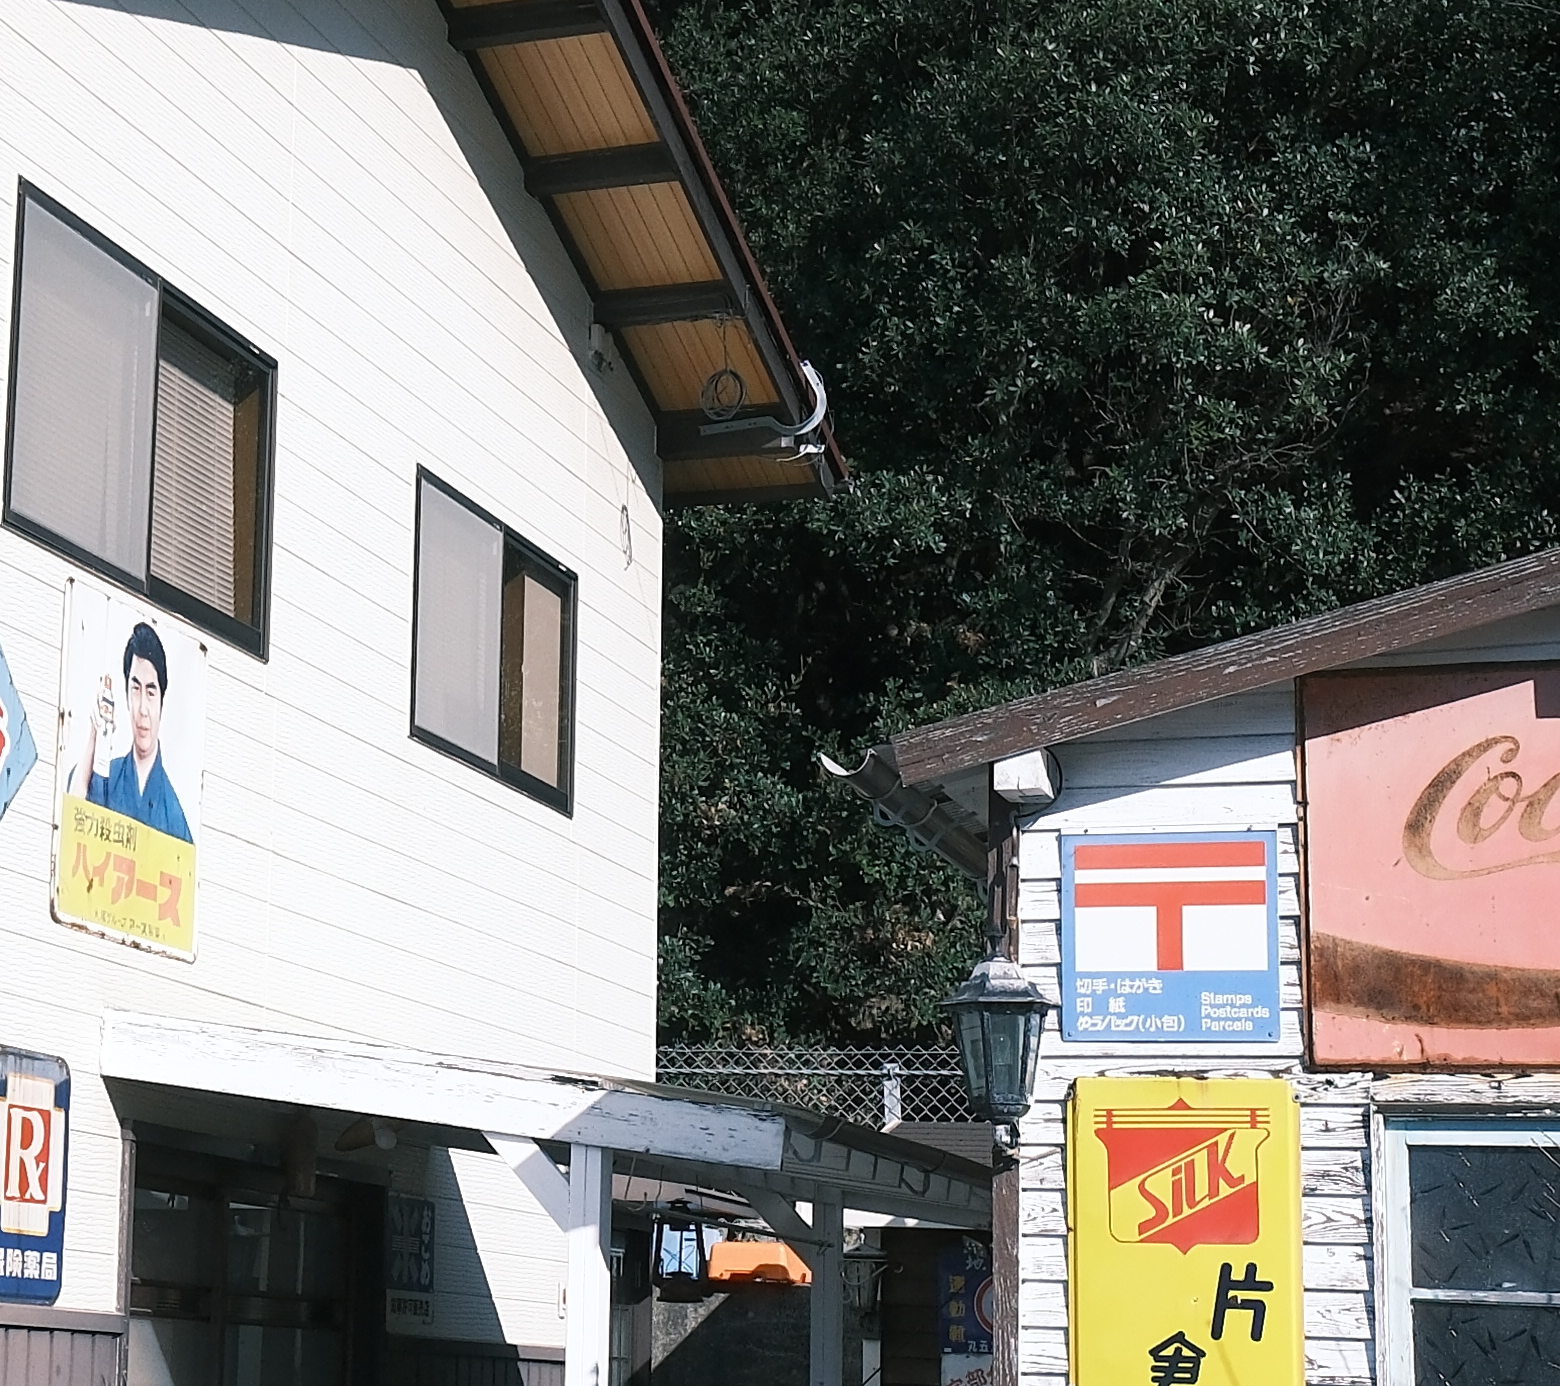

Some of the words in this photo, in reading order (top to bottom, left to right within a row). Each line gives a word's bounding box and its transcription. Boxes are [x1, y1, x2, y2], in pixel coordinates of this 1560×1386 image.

[74, 807, 138, 852] 強力殺虫剤
[72, 842, 183, 928] ハイアース
[1200, 991, 1253, 1005] Stamps
[1200, 1004, 1271, 1017] Postcards
[1201, 1017, 1254, 1031] Parcels
